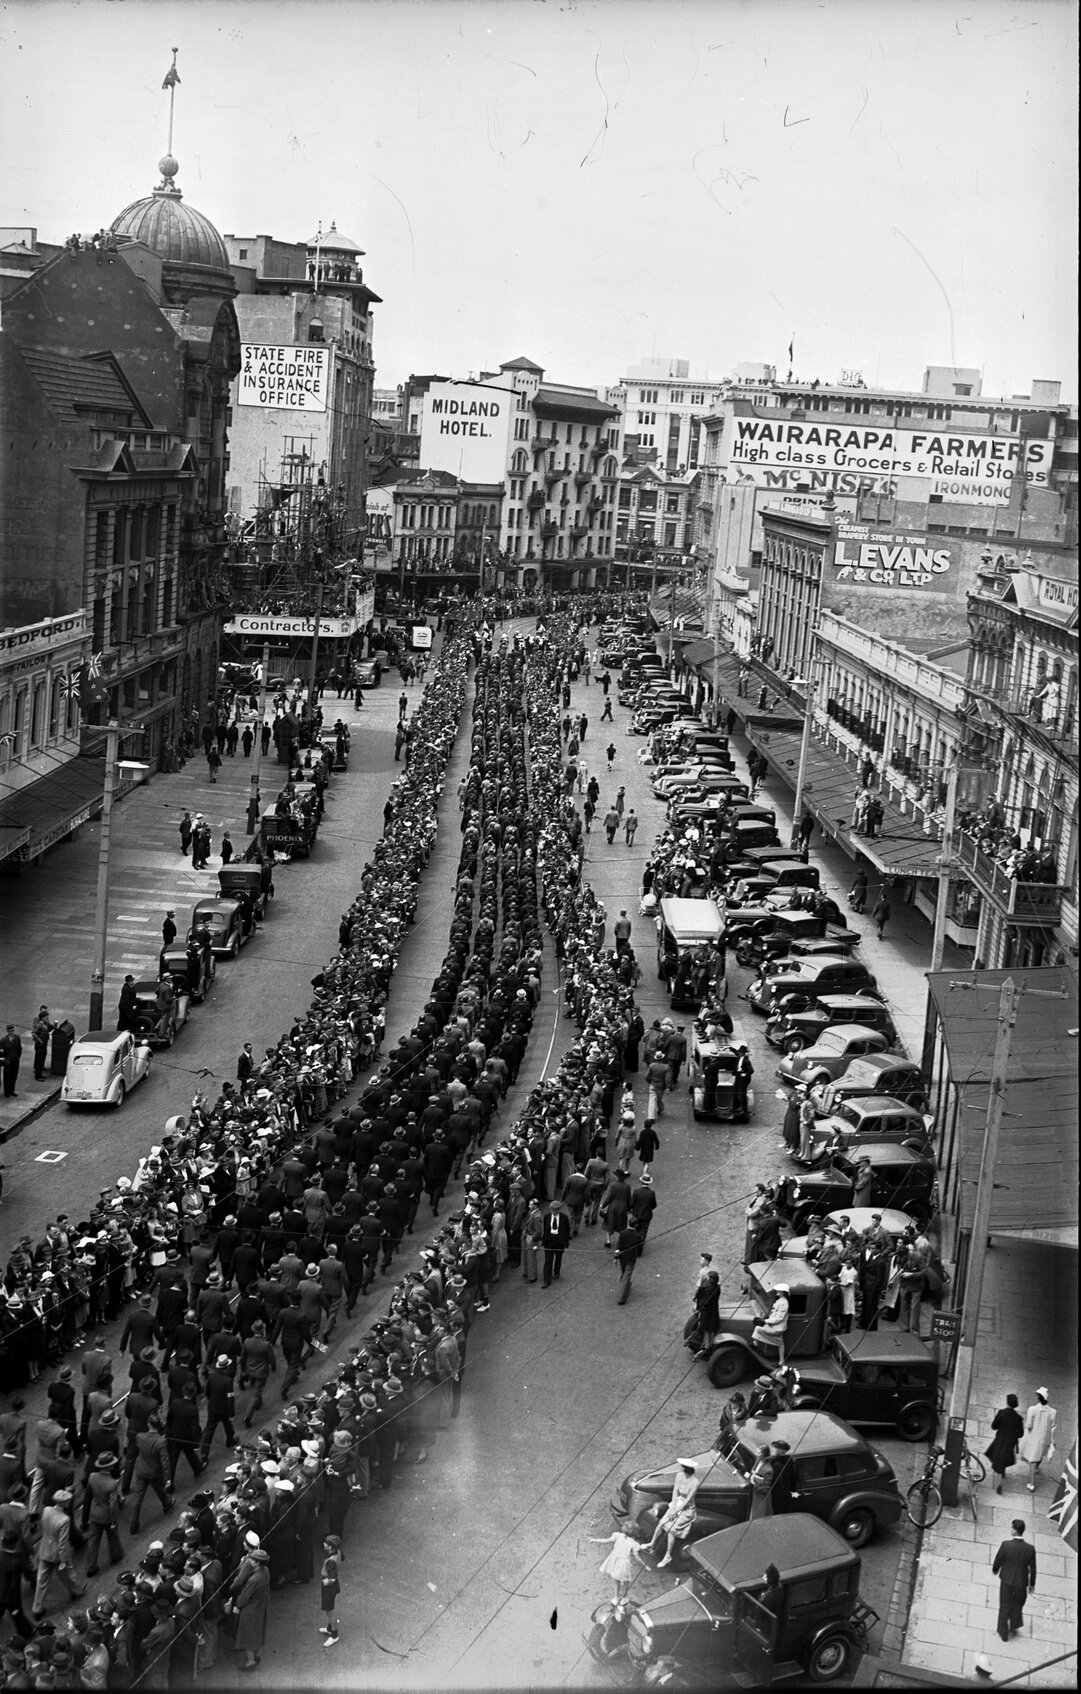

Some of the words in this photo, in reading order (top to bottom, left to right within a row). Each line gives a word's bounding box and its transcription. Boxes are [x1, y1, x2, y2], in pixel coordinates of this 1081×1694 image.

[245, 346, 285, 361] STATE
[295, 349, 323, 364] FIRE
[244, 361, 253, 373] &
[259, 361, 323, 378] ACCIDENT
[244, 375, 321, 393] INSURANCE
[260, 390, 306, 406] OFFICE
[432, 398, 500, 417] MIDLAND
[440, 419, 492, 437] HOTEL.
[738, 421, 897, 452] WAIRARAPA
[911, 435, 1045, 463] FARMERS
[733, 440, 769, 462] High
[776, 442, 827, 465] class
[834, 448, 912, 472] Grocers
[917, 461, 928, 473] &
[932, 455, 980, 478] Retail
[985, 461, 1046, 483] Stoes
[871, 534, 893, 542] STORE
[905, 536, 926, 545] TOWN
[1044, 580, 1066, 604] ROYAL
[933, 1327, 955, 1337] STOP
